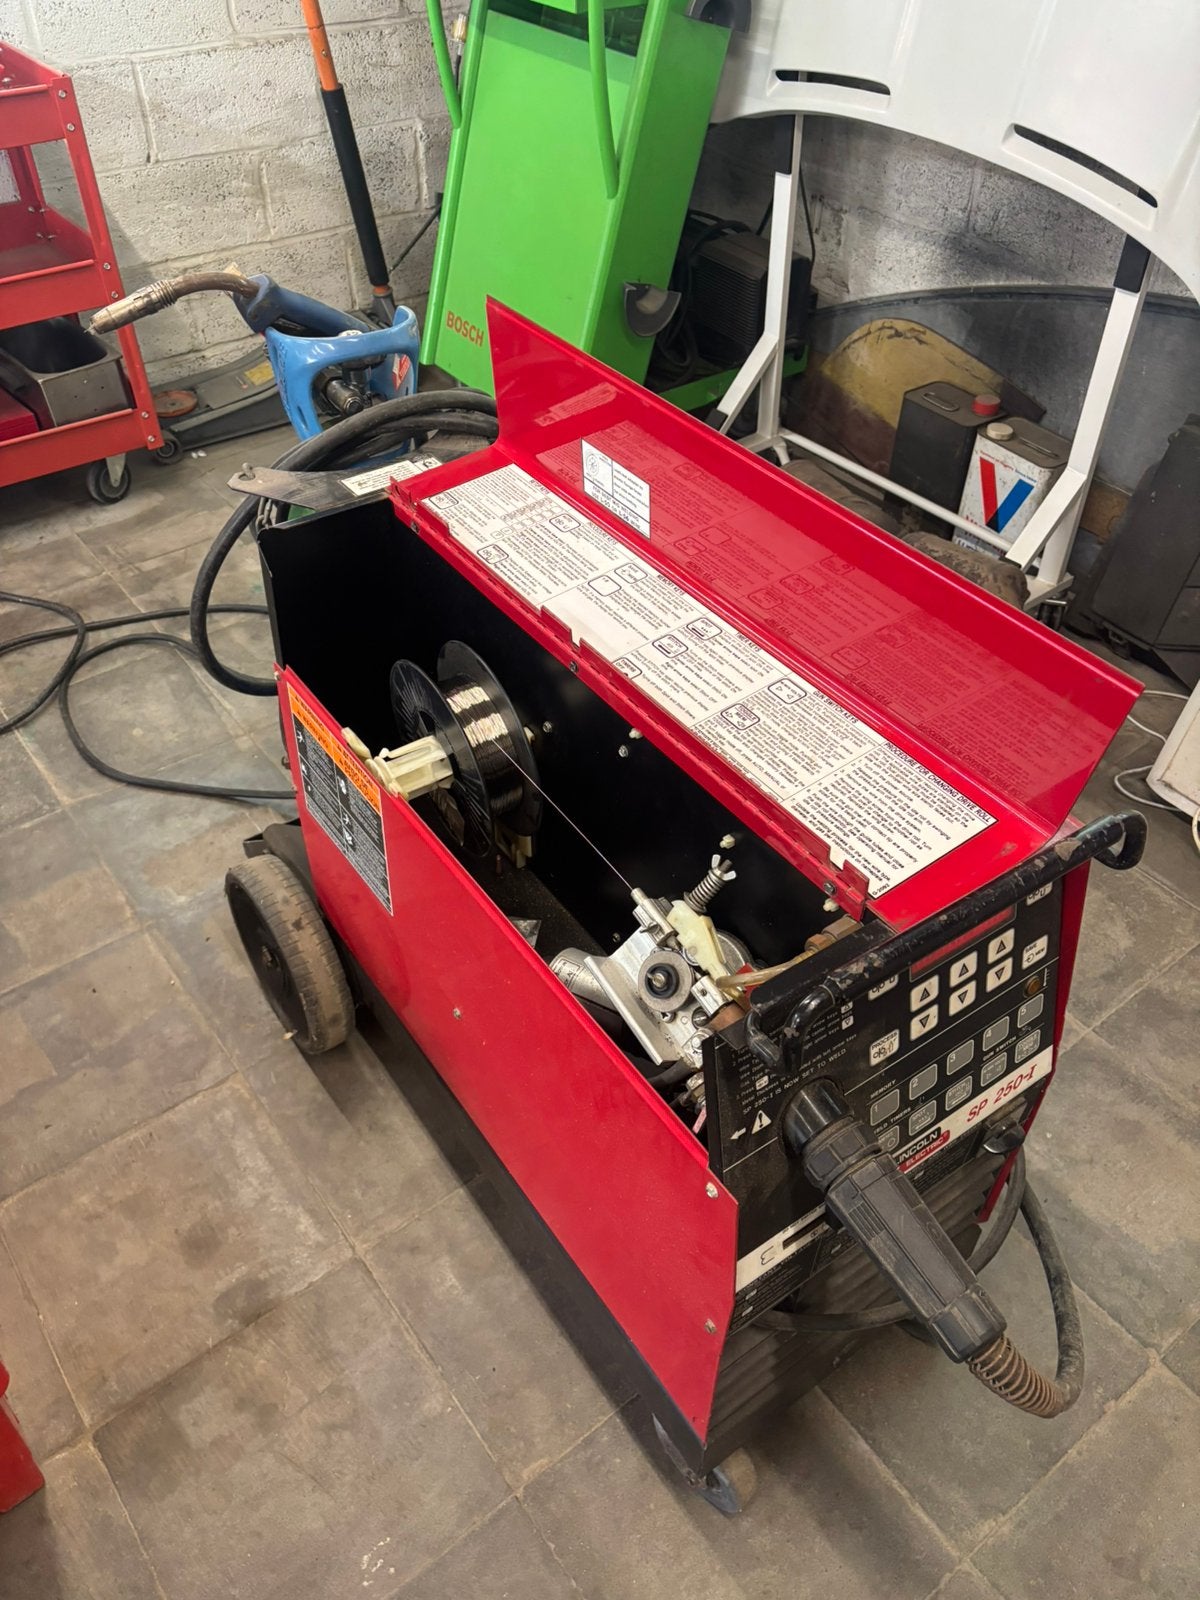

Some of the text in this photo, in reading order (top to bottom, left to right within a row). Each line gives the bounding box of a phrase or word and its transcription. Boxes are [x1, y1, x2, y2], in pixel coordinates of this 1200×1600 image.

[446, 311, 484, 347] BOSCH
[655, 574, 686, 595] MEMORY KEYS
[733, 631, 762, 652] TIMER KEYS
[811, 690, 859, 724] GUN SWITCH KEYS
[883, 742, 993, 823] PROCEDURE FOR CHANGING DRIVE ROLL
[1021, 1006, 1027, 1016] 5
[871, 1031, 897, 1050] PROCESS
[985, 1029, 992, 1038] 4
[995, 1036, 1017, 1052] SWITCH
[949, 1054, 956, 1063] 3
[743, 1106, 752, 1115] SP
[784, 1077, 799, 1089] NOW
[802, 1068, 814, 1079] SET
[818, 1061, 826, 1069] TO
[829, 1049, 846, 1062] WELD
[870, 1079, 896, 1099] MEMORY
[912, 1078, 919, 1088] 2
[966, 1063, 1038, 1122] SP 250-I
[874, 1104, 878, 1113] 1
[890, 1107, 911, 1124] TIMERS
[897, 1130, 938, 1163] INCOLN
[905, 1136, 944, 1167] ELECTRIC
